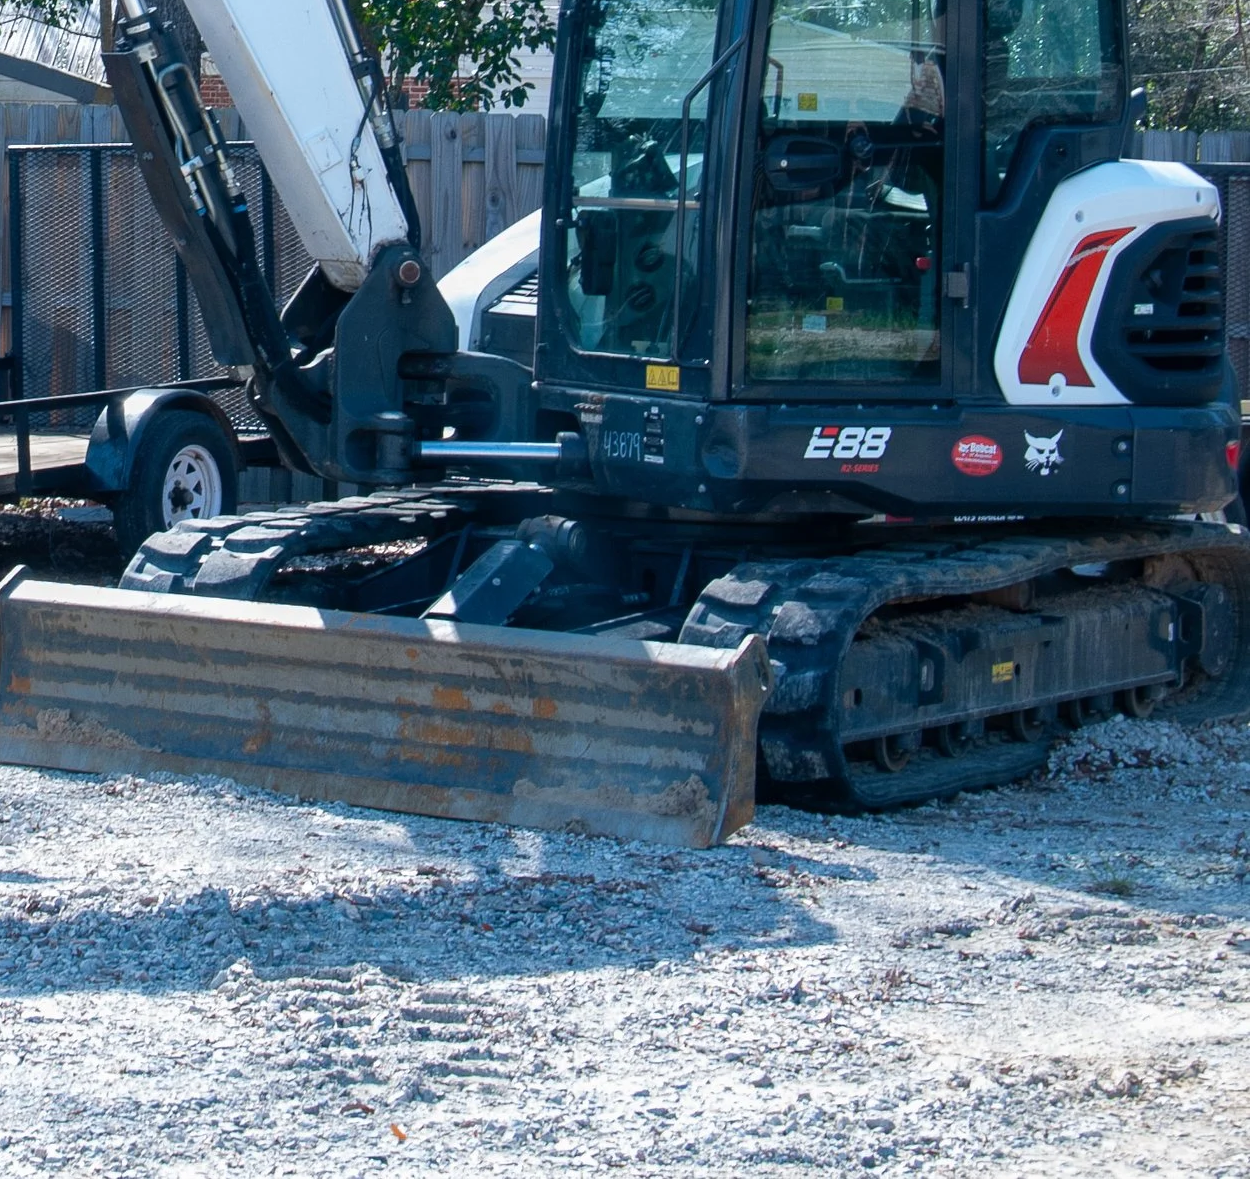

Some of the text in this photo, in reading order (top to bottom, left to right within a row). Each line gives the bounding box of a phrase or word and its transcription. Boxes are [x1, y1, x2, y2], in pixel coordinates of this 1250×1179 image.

[603, 430, 641, 461] 43879
[803, 426, 892, 458] E88
[970, 442, 997, 455] Bobcat
